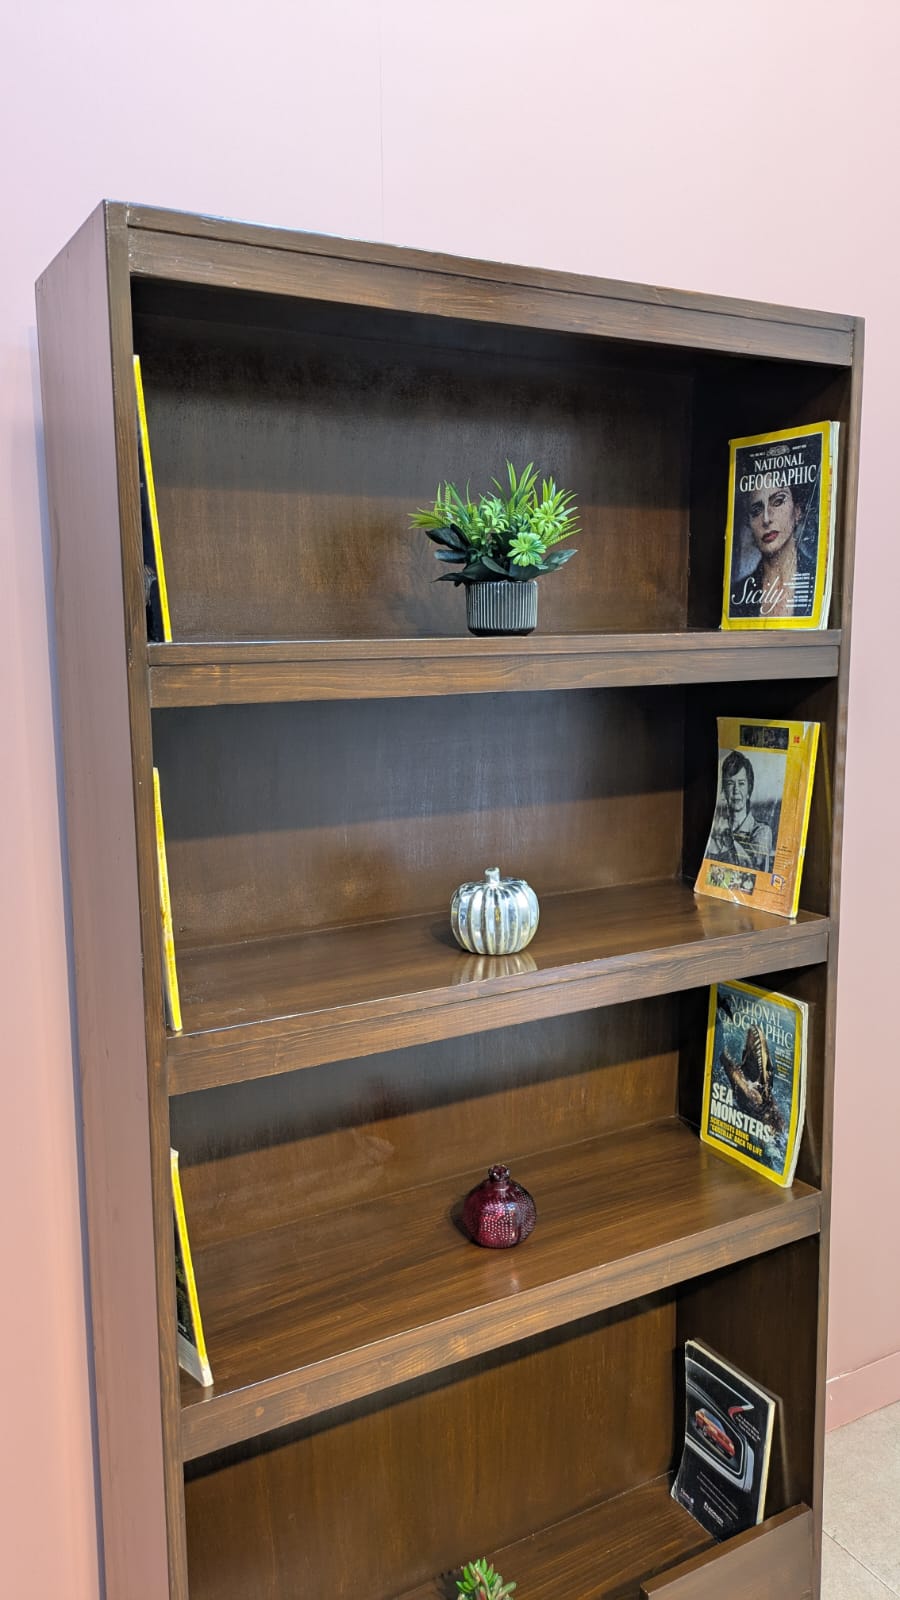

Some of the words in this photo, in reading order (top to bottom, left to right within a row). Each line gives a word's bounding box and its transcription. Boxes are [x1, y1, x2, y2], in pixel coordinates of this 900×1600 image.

[754, 453, 804, 472] NATIONAL
[739, 465, 817, 492] GEOGRAPHIC
[731, 576, 784, 615] Sicily
[730, 994, 782, 1028] NATIONAL
[712, 1082, 733, 1107] SEA
[710, 1098, 771, 1142] MONSTERS
[734, 1135, 746, 1148] BACK
[746, 1142, 753, 1151] TO
[752, 1144, 763, 1157] LIFE
